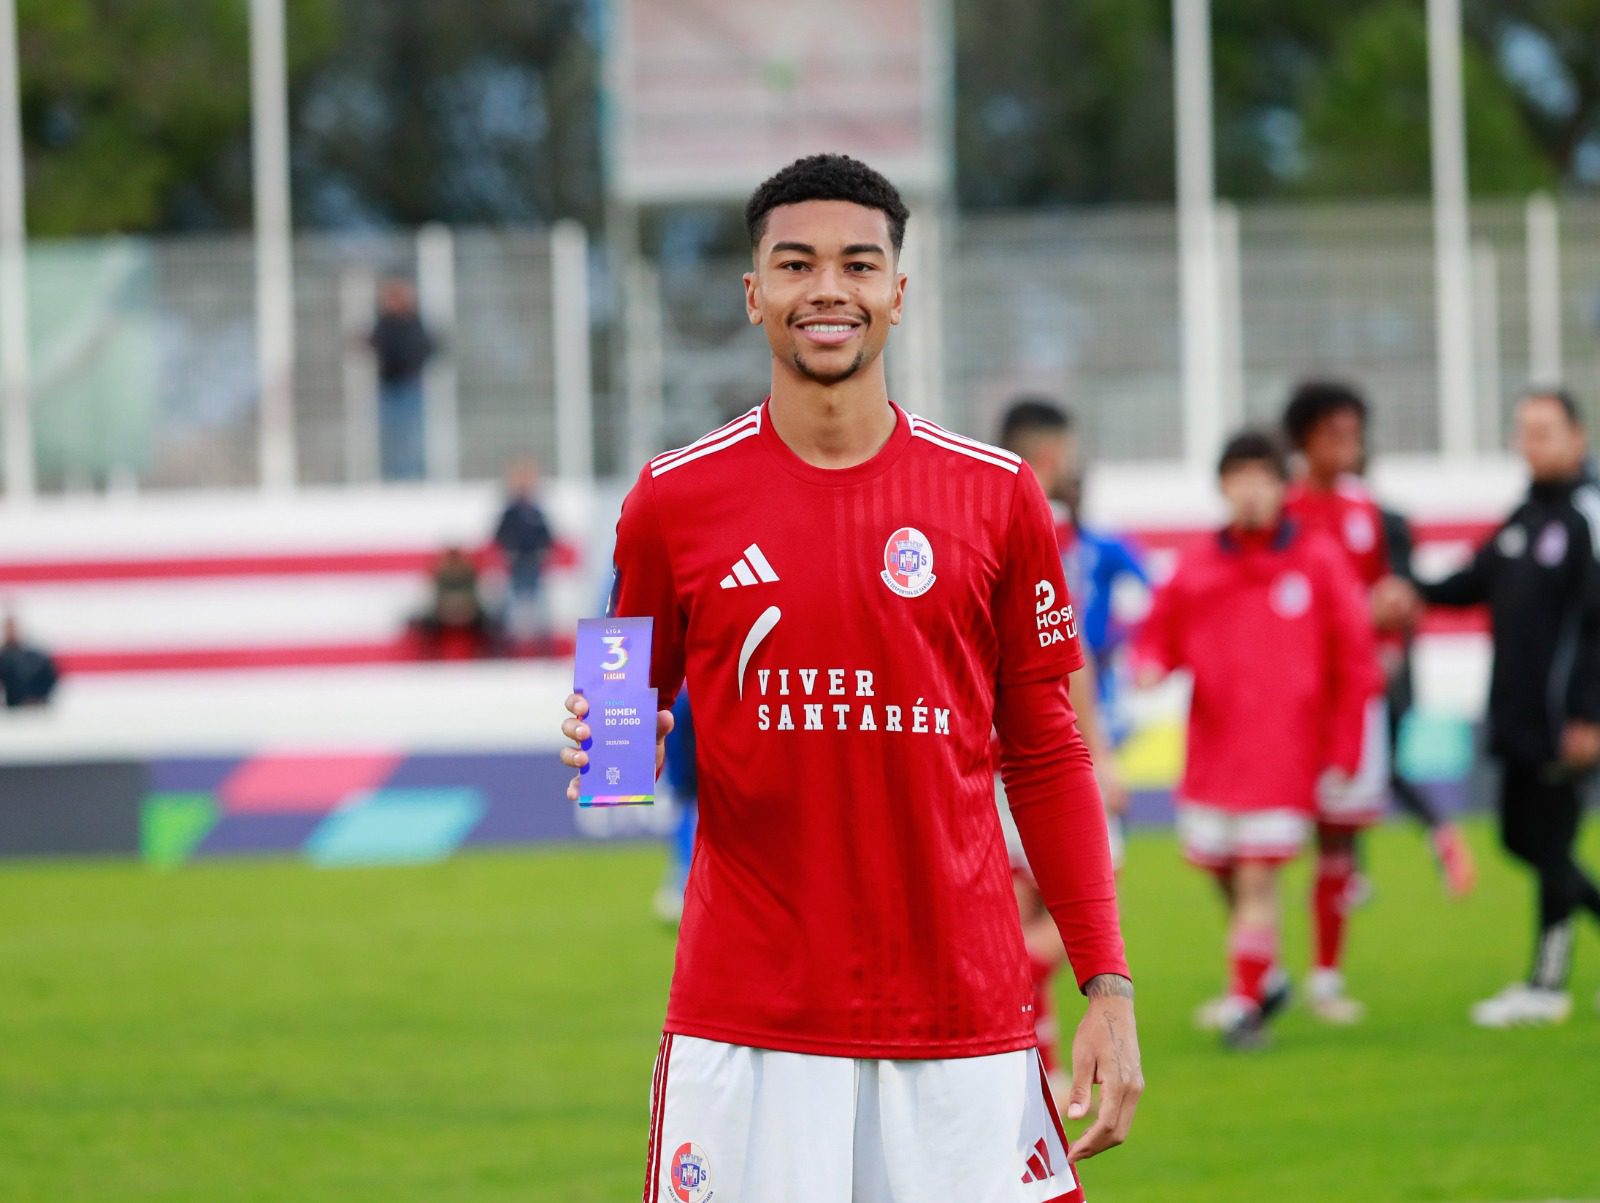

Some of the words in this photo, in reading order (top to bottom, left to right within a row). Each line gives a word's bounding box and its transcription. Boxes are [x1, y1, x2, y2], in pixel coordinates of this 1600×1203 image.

[921, 555, 927, 566] S
[1038, 628, 1065, 648] DA
[600, 636, 629, 671] 3
[757, 668, 875, 697] VIVER
[605, 708, 637, 717] HOMEM
[757, 697, 950, 735] SANTARÉM
[605, 718, 616, 726] DO
[618, 717, 641, 726] JOGO
[701, 1170, 706, 1181] S
